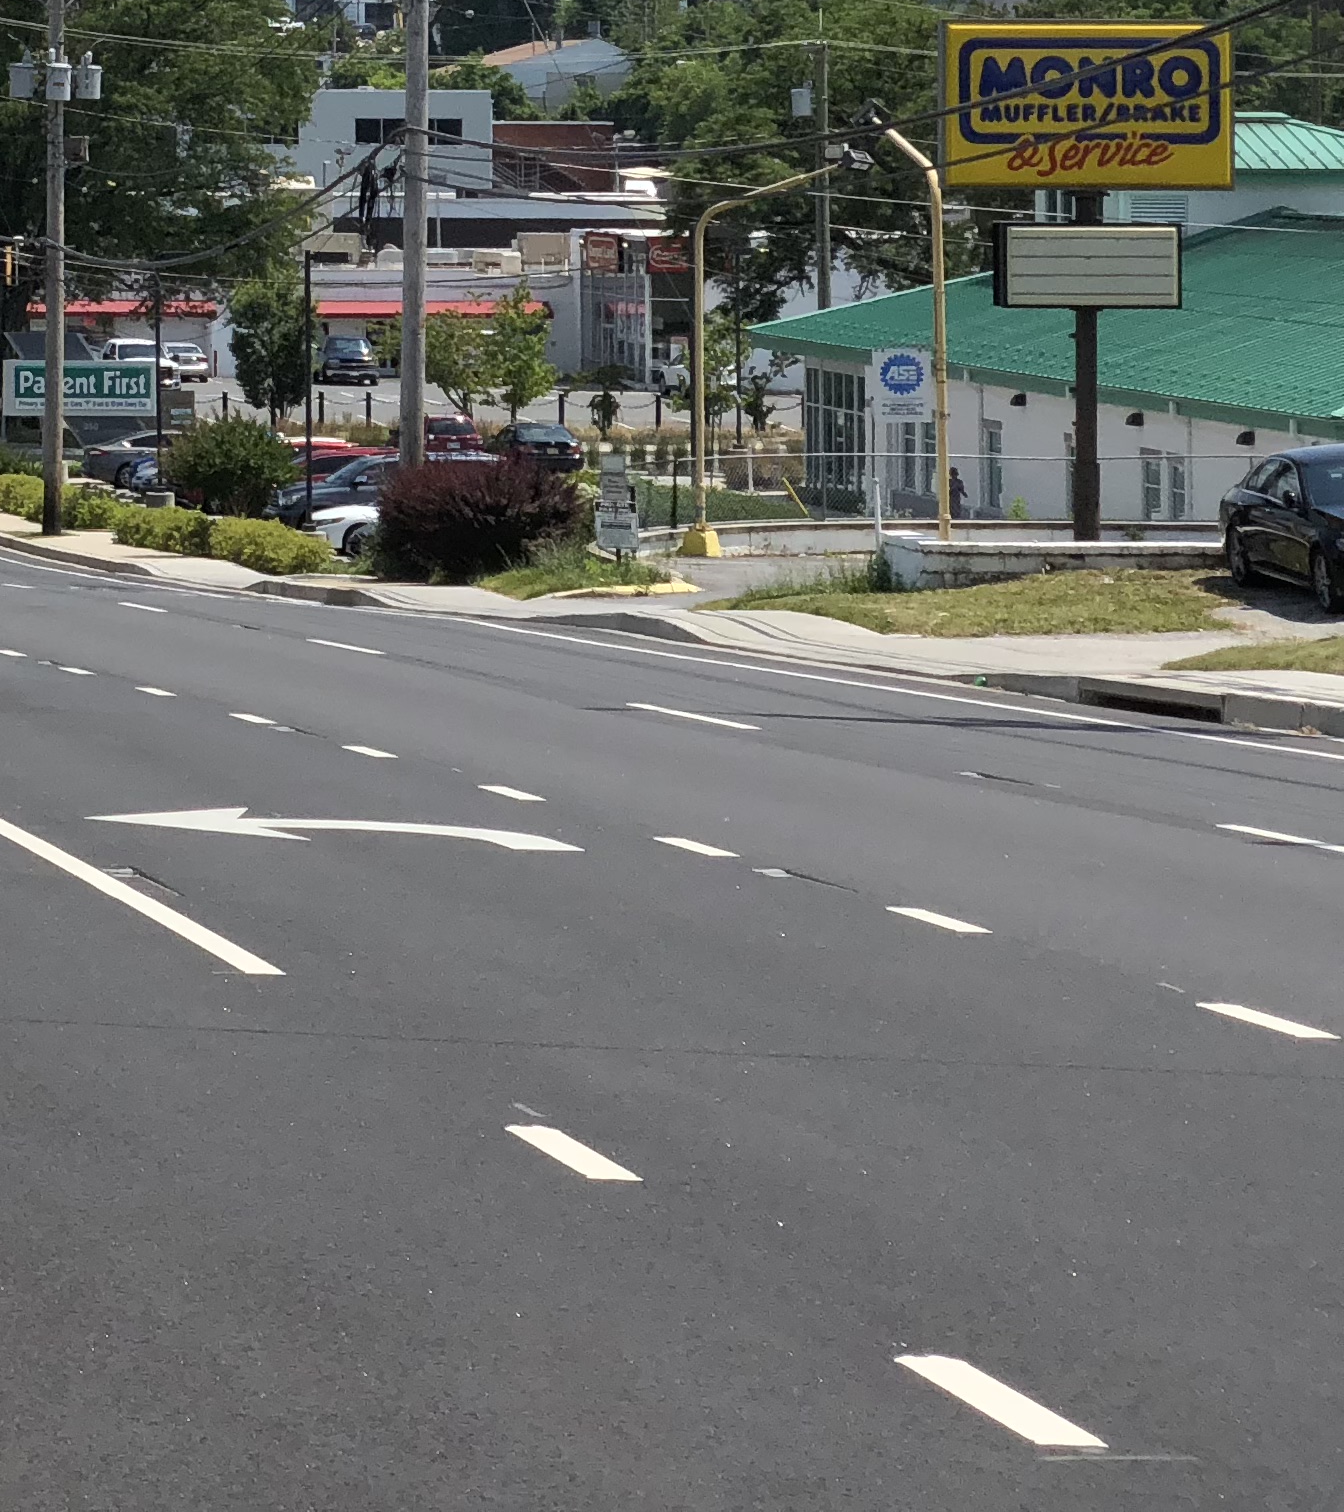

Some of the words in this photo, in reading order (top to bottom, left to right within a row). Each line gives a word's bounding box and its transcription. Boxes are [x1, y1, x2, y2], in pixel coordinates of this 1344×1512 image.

[979, 55, 1203, 99] MONRO
[979, 103, 1202, 123] MUFFLER/BRAKE
[19, 371, 97, 395] Paent
[103, 371, 147, 395] First
[885, 365, 918, 380] ASE
